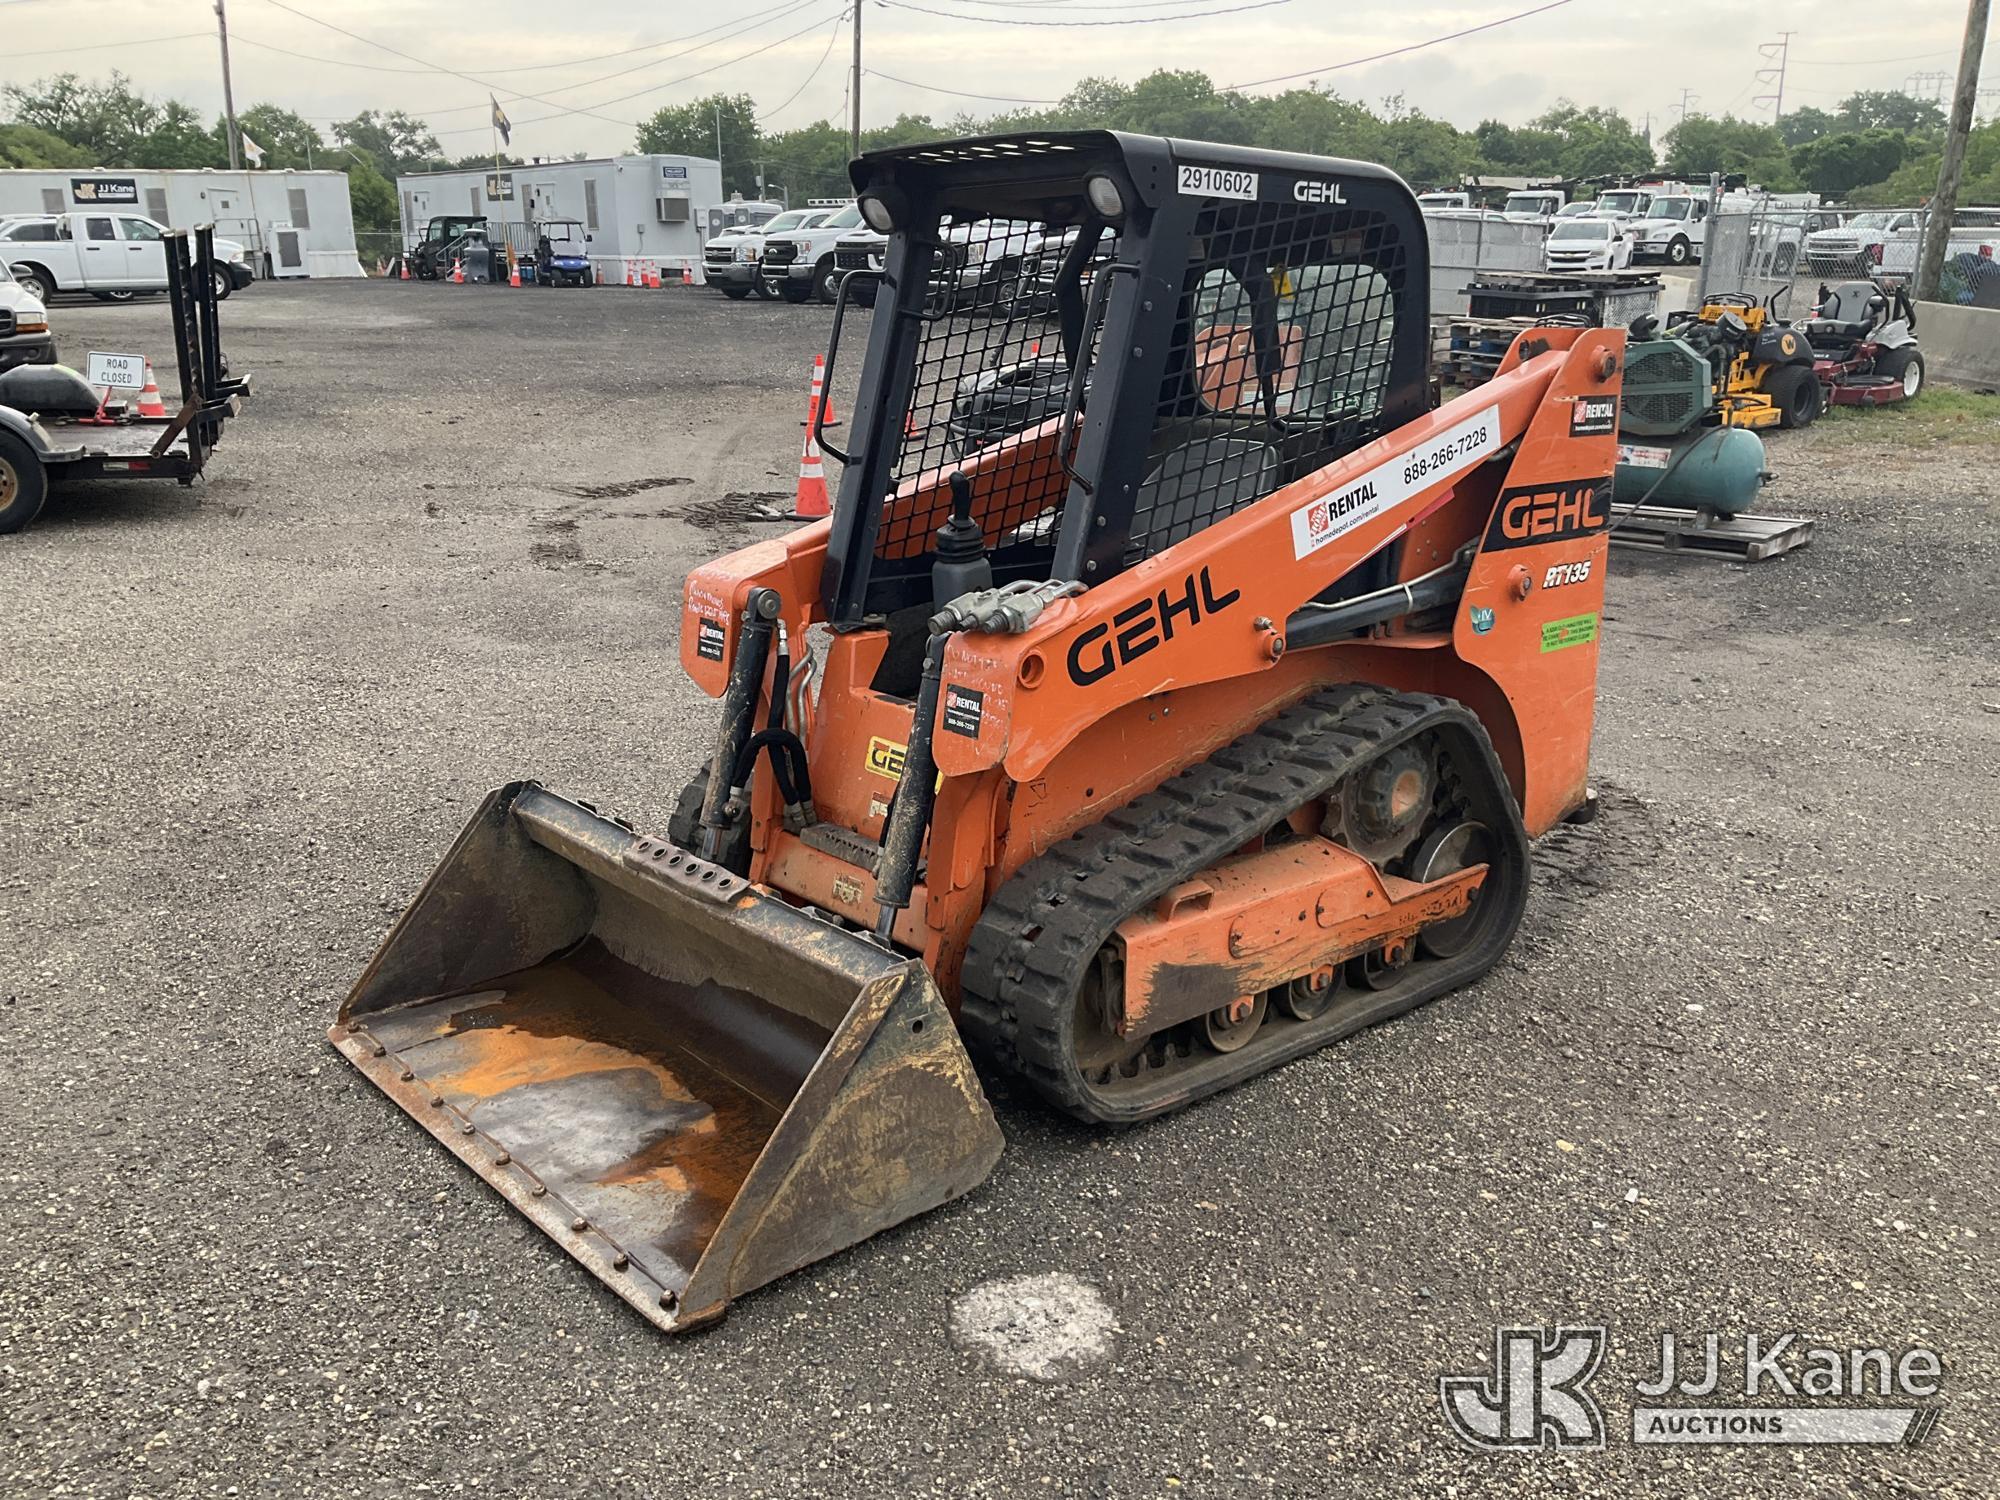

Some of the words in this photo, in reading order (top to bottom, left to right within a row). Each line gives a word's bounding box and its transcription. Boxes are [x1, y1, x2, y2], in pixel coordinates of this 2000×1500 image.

[98, 184, 108, 193] JJ
[110, 184, 135, 193] Kane
[1182, 167, 1253, 194] 2910602
[1293, 180, 1347, 205] GEHL
[101, 371, 133, 384] CLOSED
[106, 358, 128, 370] ROAD
[1585, 403, 1615, 419] RENTAL
[1403, 426, 1488, 485] 888-266-7228
[1328, 480, 1378, 522] RENTAL
[1502, 487, 1604, 540] GEHL
[1315, 503, 1380, 545] homedepot.com/rental
[1541, 560, 1592, 590] RT135
[1066, 565, 1241, 687] GEHL
[956, 697, 981, 713] RENTAL
[872, 740, 905, 775] GE
